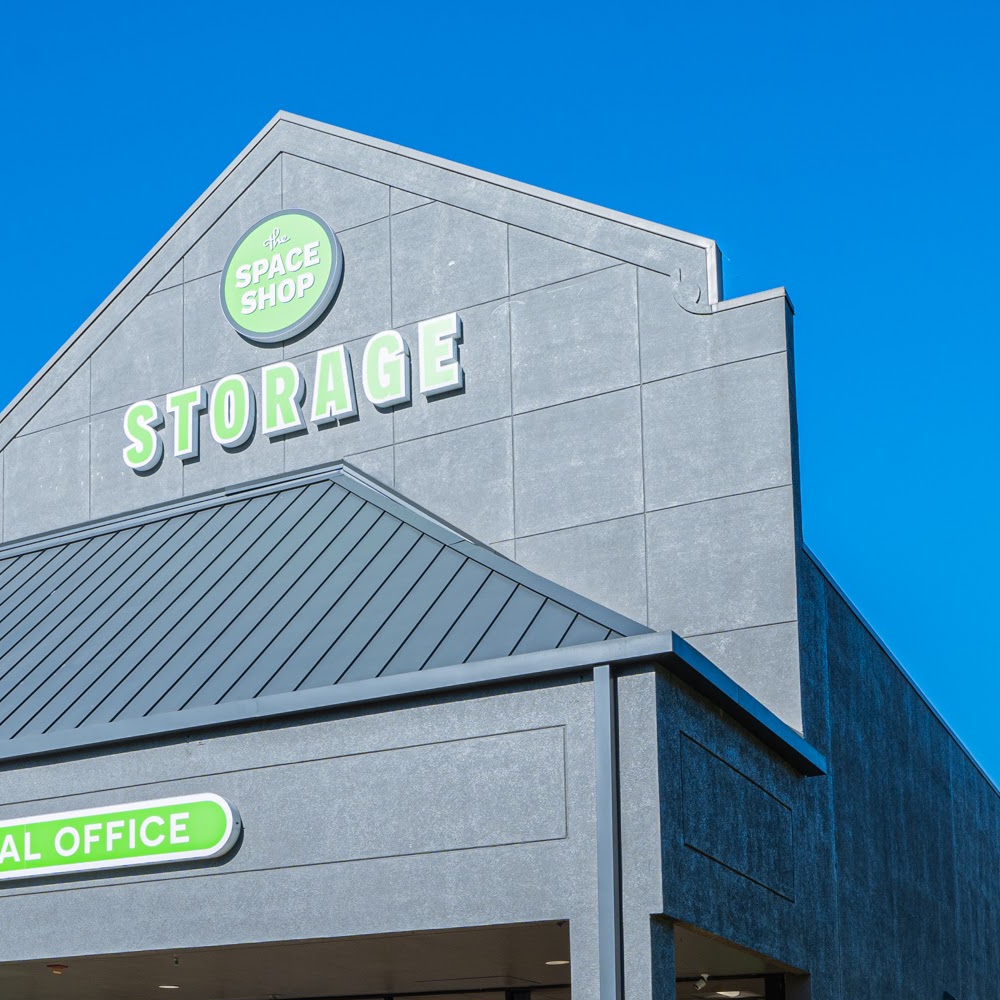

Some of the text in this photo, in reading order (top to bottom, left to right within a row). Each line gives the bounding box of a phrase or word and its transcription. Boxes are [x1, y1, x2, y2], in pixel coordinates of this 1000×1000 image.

[264, 227, 291, 251] the
[235, 240, 321, 289] SPACE
[240, 272, 315, 315] SHOP
[122, 312, 464, 472] STORAGE
[54, 812, 191, 858] OFFICE
